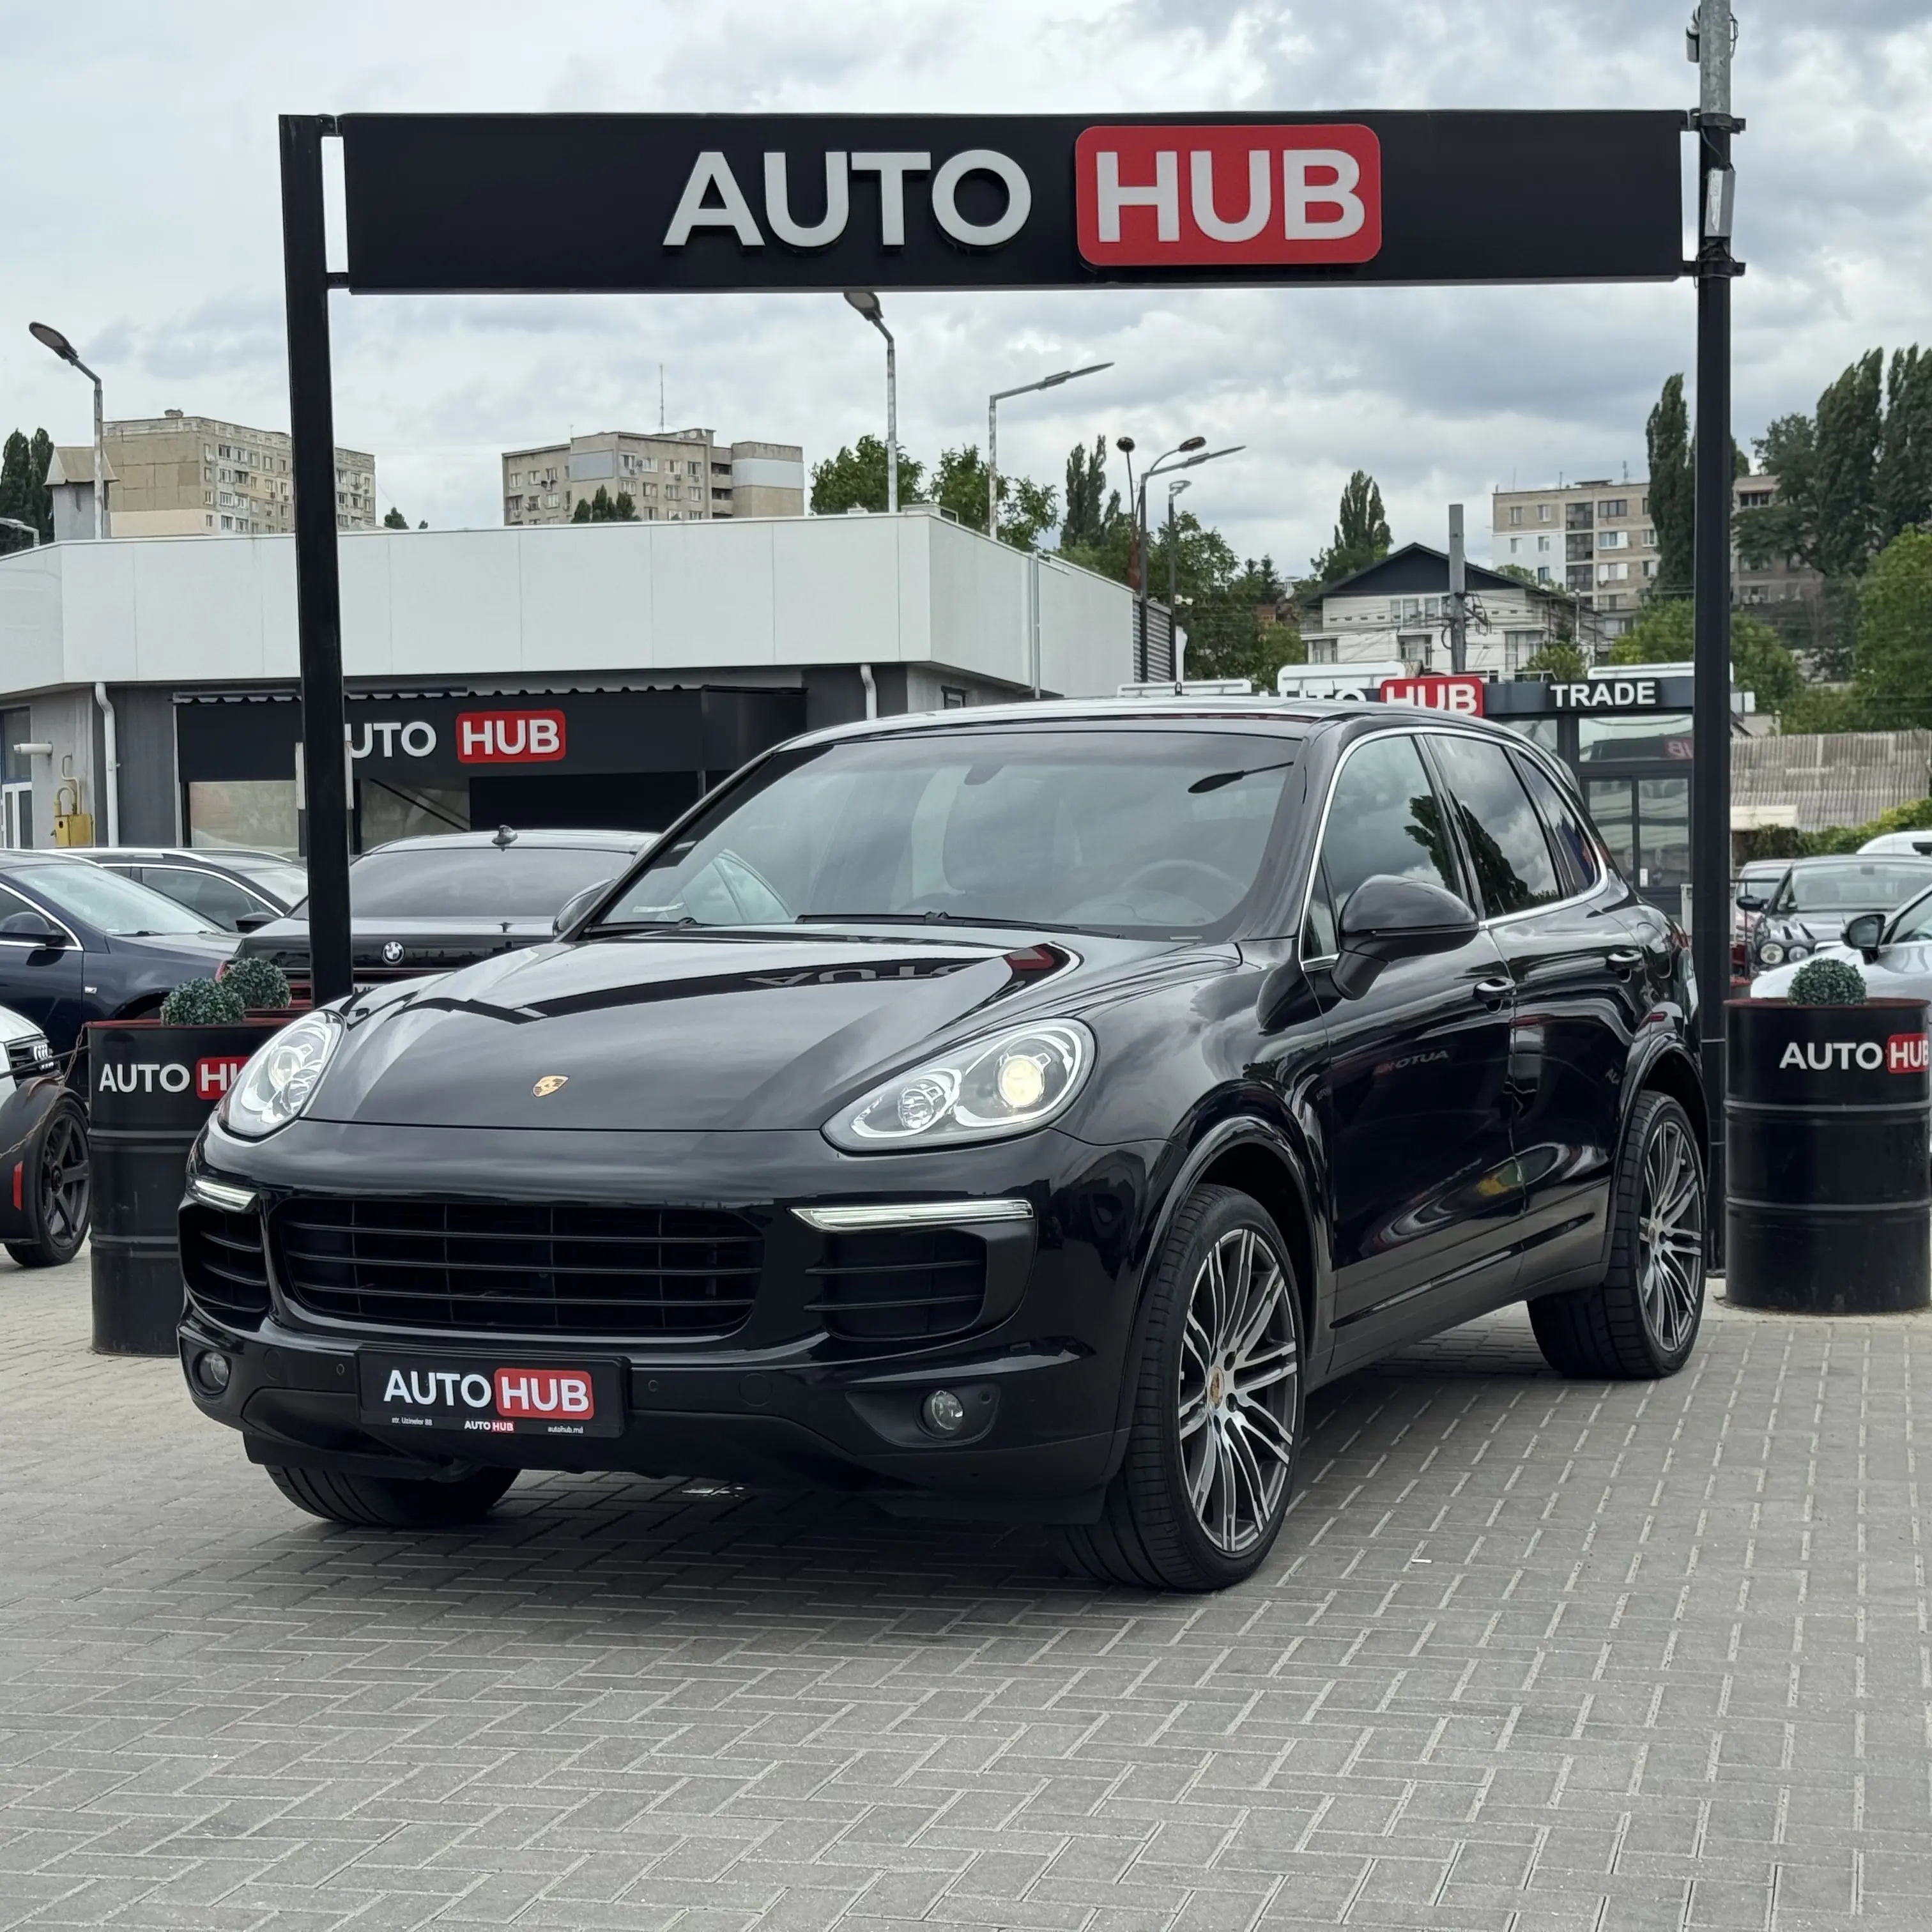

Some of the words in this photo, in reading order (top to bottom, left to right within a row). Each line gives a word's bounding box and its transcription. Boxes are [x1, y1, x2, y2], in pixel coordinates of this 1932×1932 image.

[663, 149, 1032, 248] AUTO
[1096, 149, 1365, 243] HUB
[1386, 683, 1478, 715] HUB
[1549, 680, 1656, 708] TRADE
[344, 721, 437, 759] UTO
[463, 719, 560, 756] HUB
[1779, 1041, 1883, 1070] AUTO
[98, 1063, 190, 1093] AUTO
[383, 1369, 492, 1408] AUTO
[501, 1376, 589, 1412] HUB
[464, 1420, 491, 1430] AUTO
[491, 1422, 514, 1432] HUB
[548, 1425, 584, 1434] autohub.md
